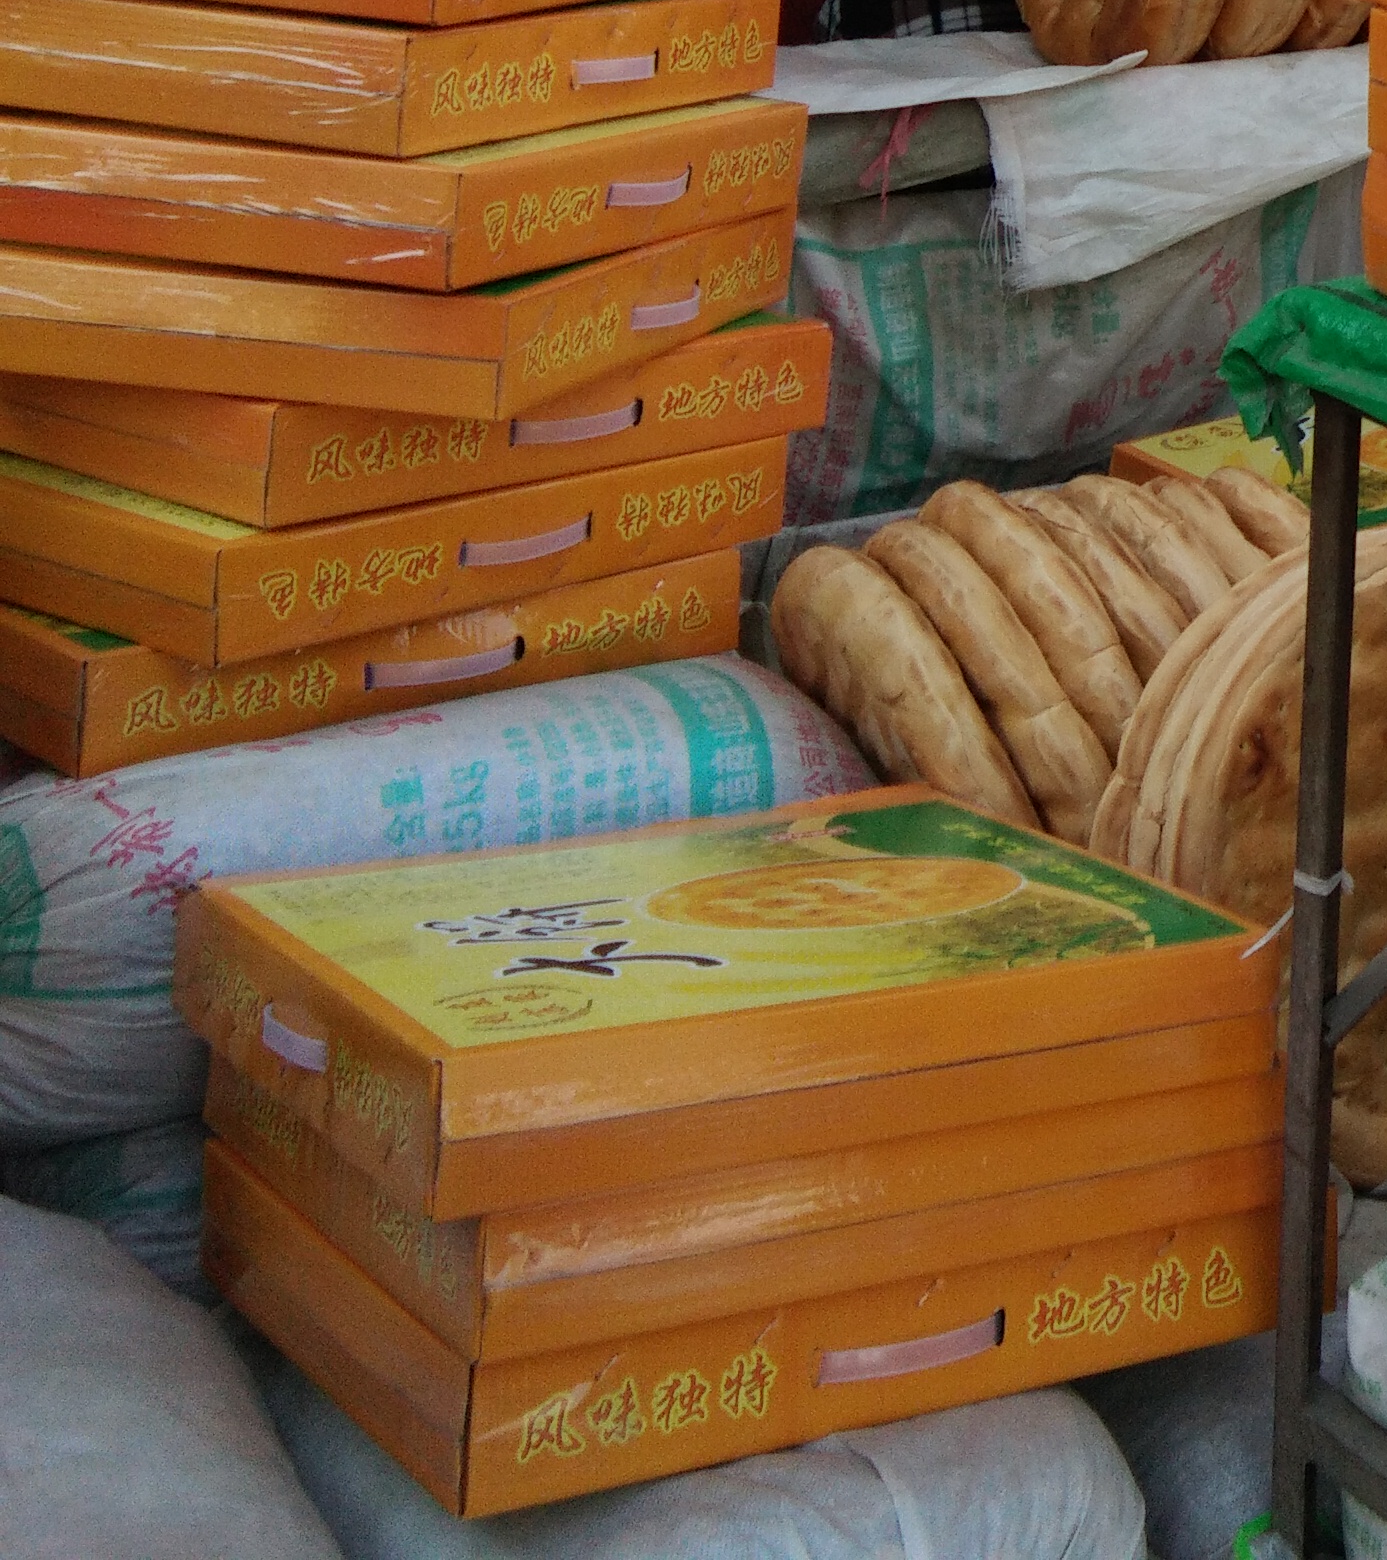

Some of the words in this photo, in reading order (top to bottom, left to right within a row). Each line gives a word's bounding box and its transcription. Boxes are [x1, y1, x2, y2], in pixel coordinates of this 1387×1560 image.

[669, 20, 763, 75] 地方特色
[430, 54, 554, 118] 风味独特
[521, 303, 621, 380] 风味独特
[657, 359, 804, 420] 地方特色
[307, 418, 490, 485] 风味独特
[617, 470, 762, 541] 风味独特
[260, 542, 443, 620] 地方特色
[541, 592, 712, 657] 地方特色
[124, 661, 338, 735] 风味独特
[1026, 1243, 1244, 1344] 地方特色
[517, 1348, 779, 1463] 风味独特
